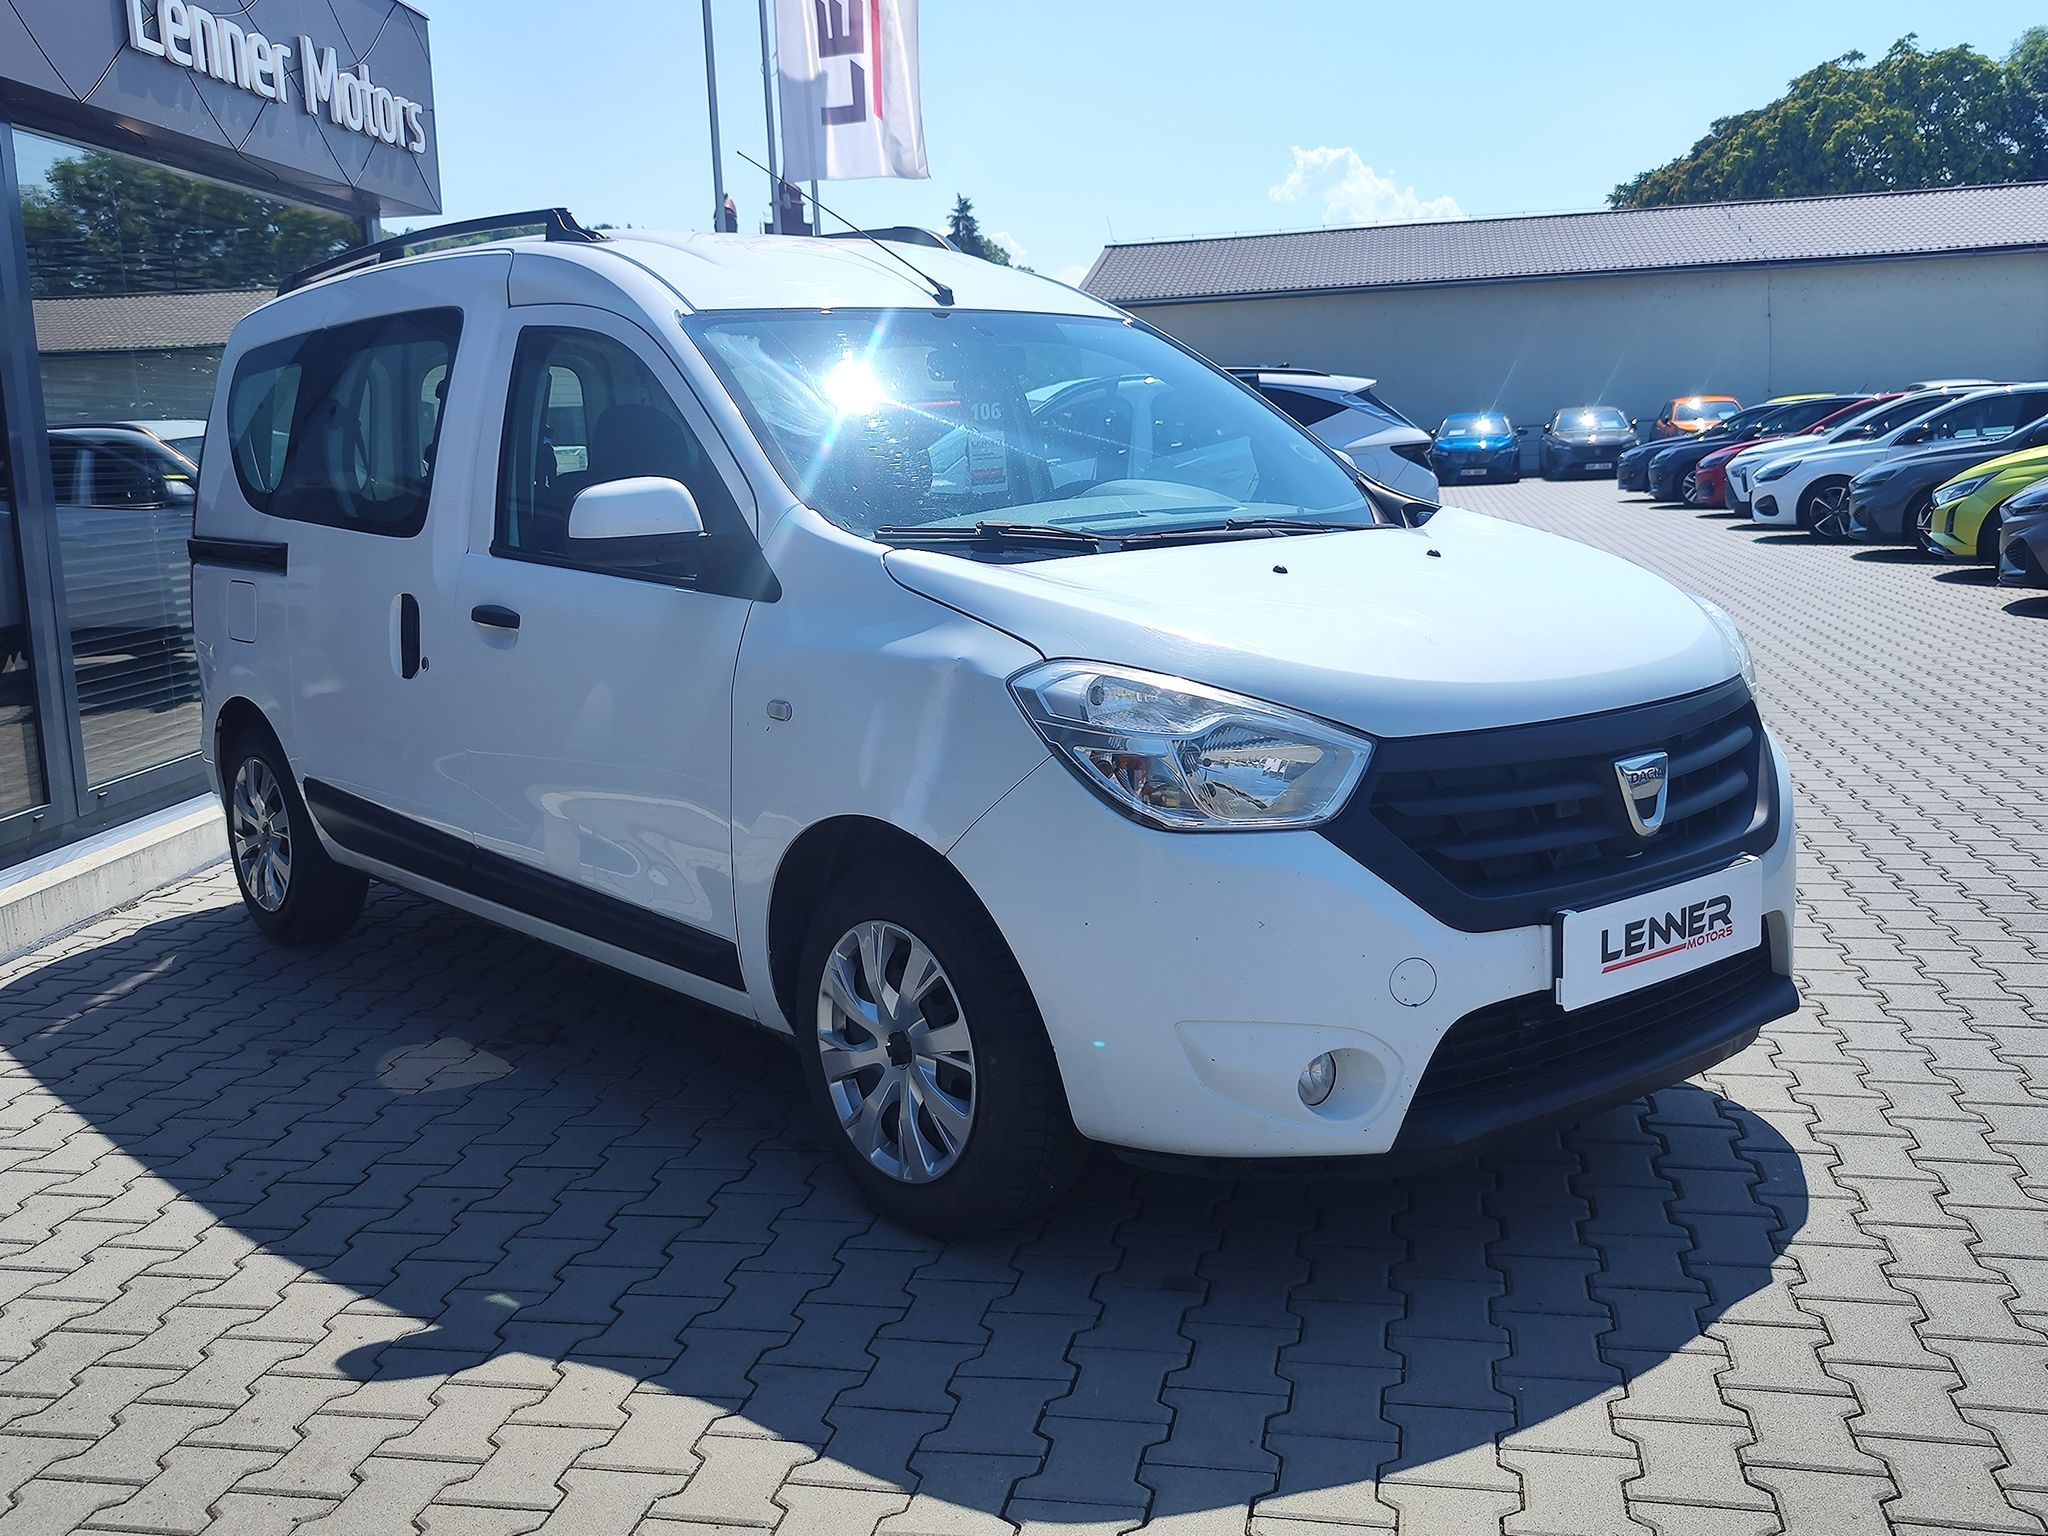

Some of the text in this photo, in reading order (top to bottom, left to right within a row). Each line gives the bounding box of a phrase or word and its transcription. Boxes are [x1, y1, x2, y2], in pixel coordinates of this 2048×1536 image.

[126, 0, 427, 154] Lenner Motors
[970, 402, 1001, 420] 106
[1601, 895, 1733, 964] LENNER
[1687, 925, 1733, 950] MOTORS
